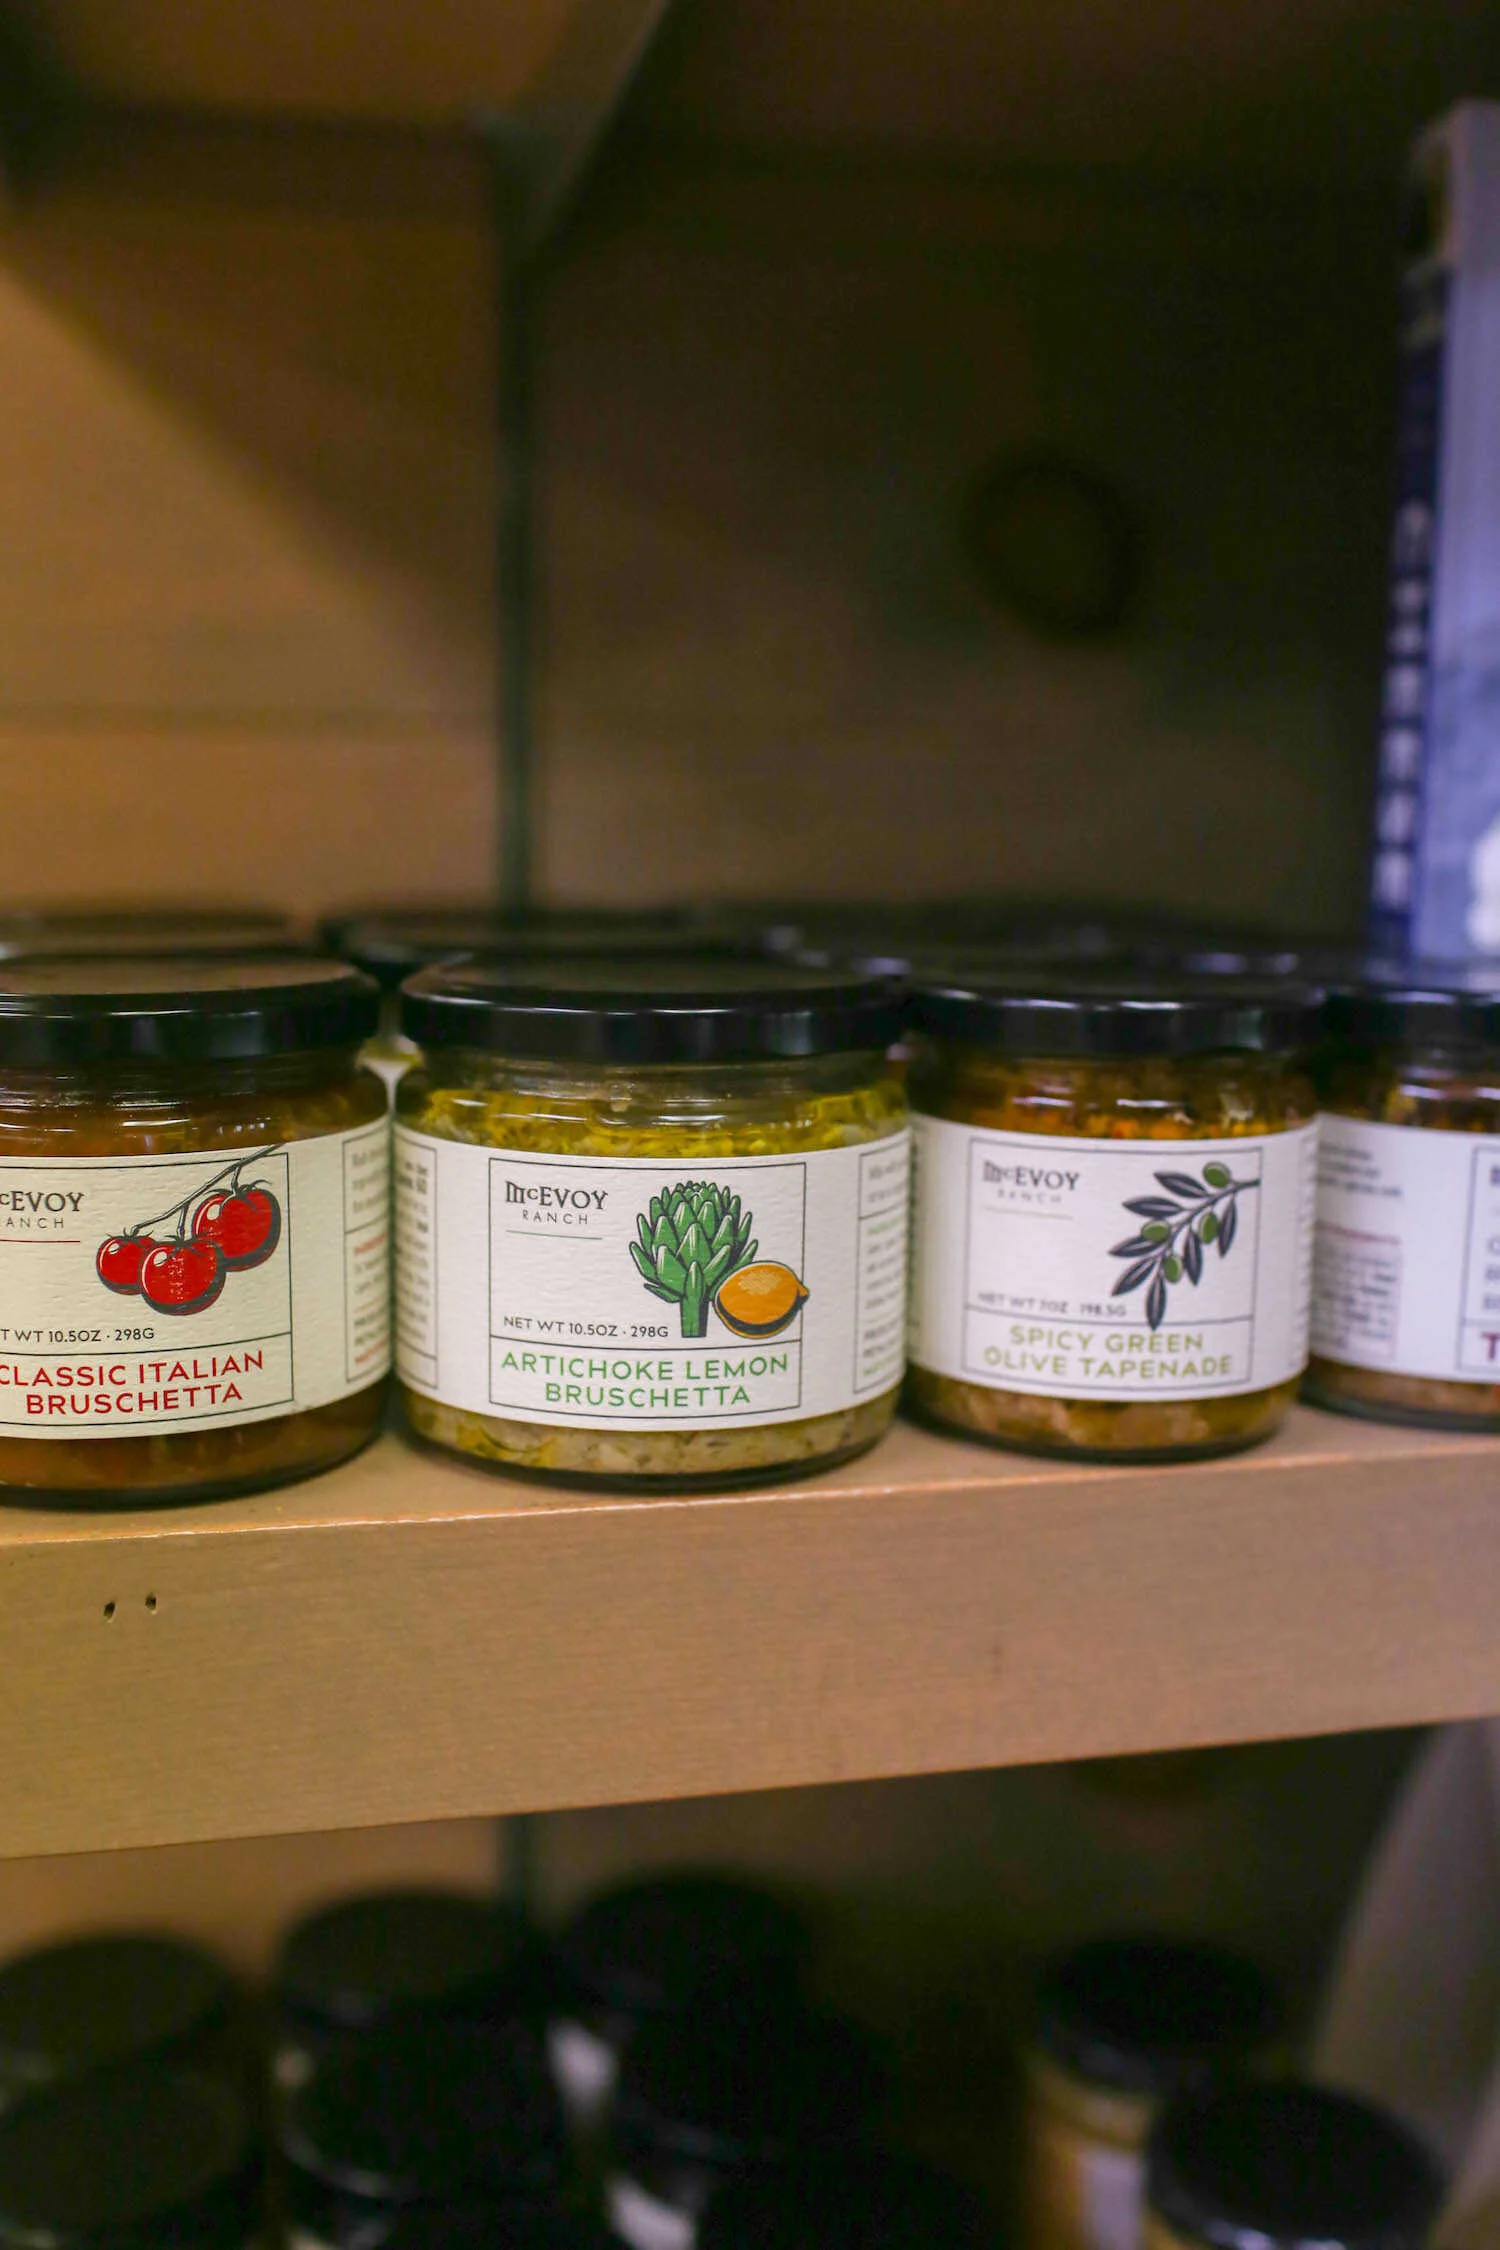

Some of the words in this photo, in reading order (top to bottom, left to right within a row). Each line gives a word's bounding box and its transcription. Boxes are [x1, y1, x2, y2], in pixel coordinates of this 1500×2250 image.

[0, 1190, 85, 1213] cEVOY
[505, 1180, 609, 1210] McEVOY
[6, 1216, 65, 1229] ANCH
[522, 1209, 588, 1225] RANCH
[15, 1329, 43, 1343] WT
[115, 1327, 156, 1342] 298G
[503, 1315, 533, 1330] NET
[537, 1319, 566, 1334] WT
[631, 1325, 670, 1338] 298G
[1009, 1323, 1094, 1352] SPICY
[1105, 1332, 1204, 1354] GREEN
[0, 1364, 127, 1388] CLASSIC
[139, 1350, 264, 1384] ITALIAN
[501, 1351, 674, 1381] ARTICHOKE
[686, 1353, 788, 1381] LEMON
[984, 1345, 1067, 1376] OLIVE
[1079, 1354, 1233, 1379] TAPENADE
[26, 1382, 244, 1416] BRUSCHETTA
[545, 1382, 751, 1408] BRUSCHETTA
